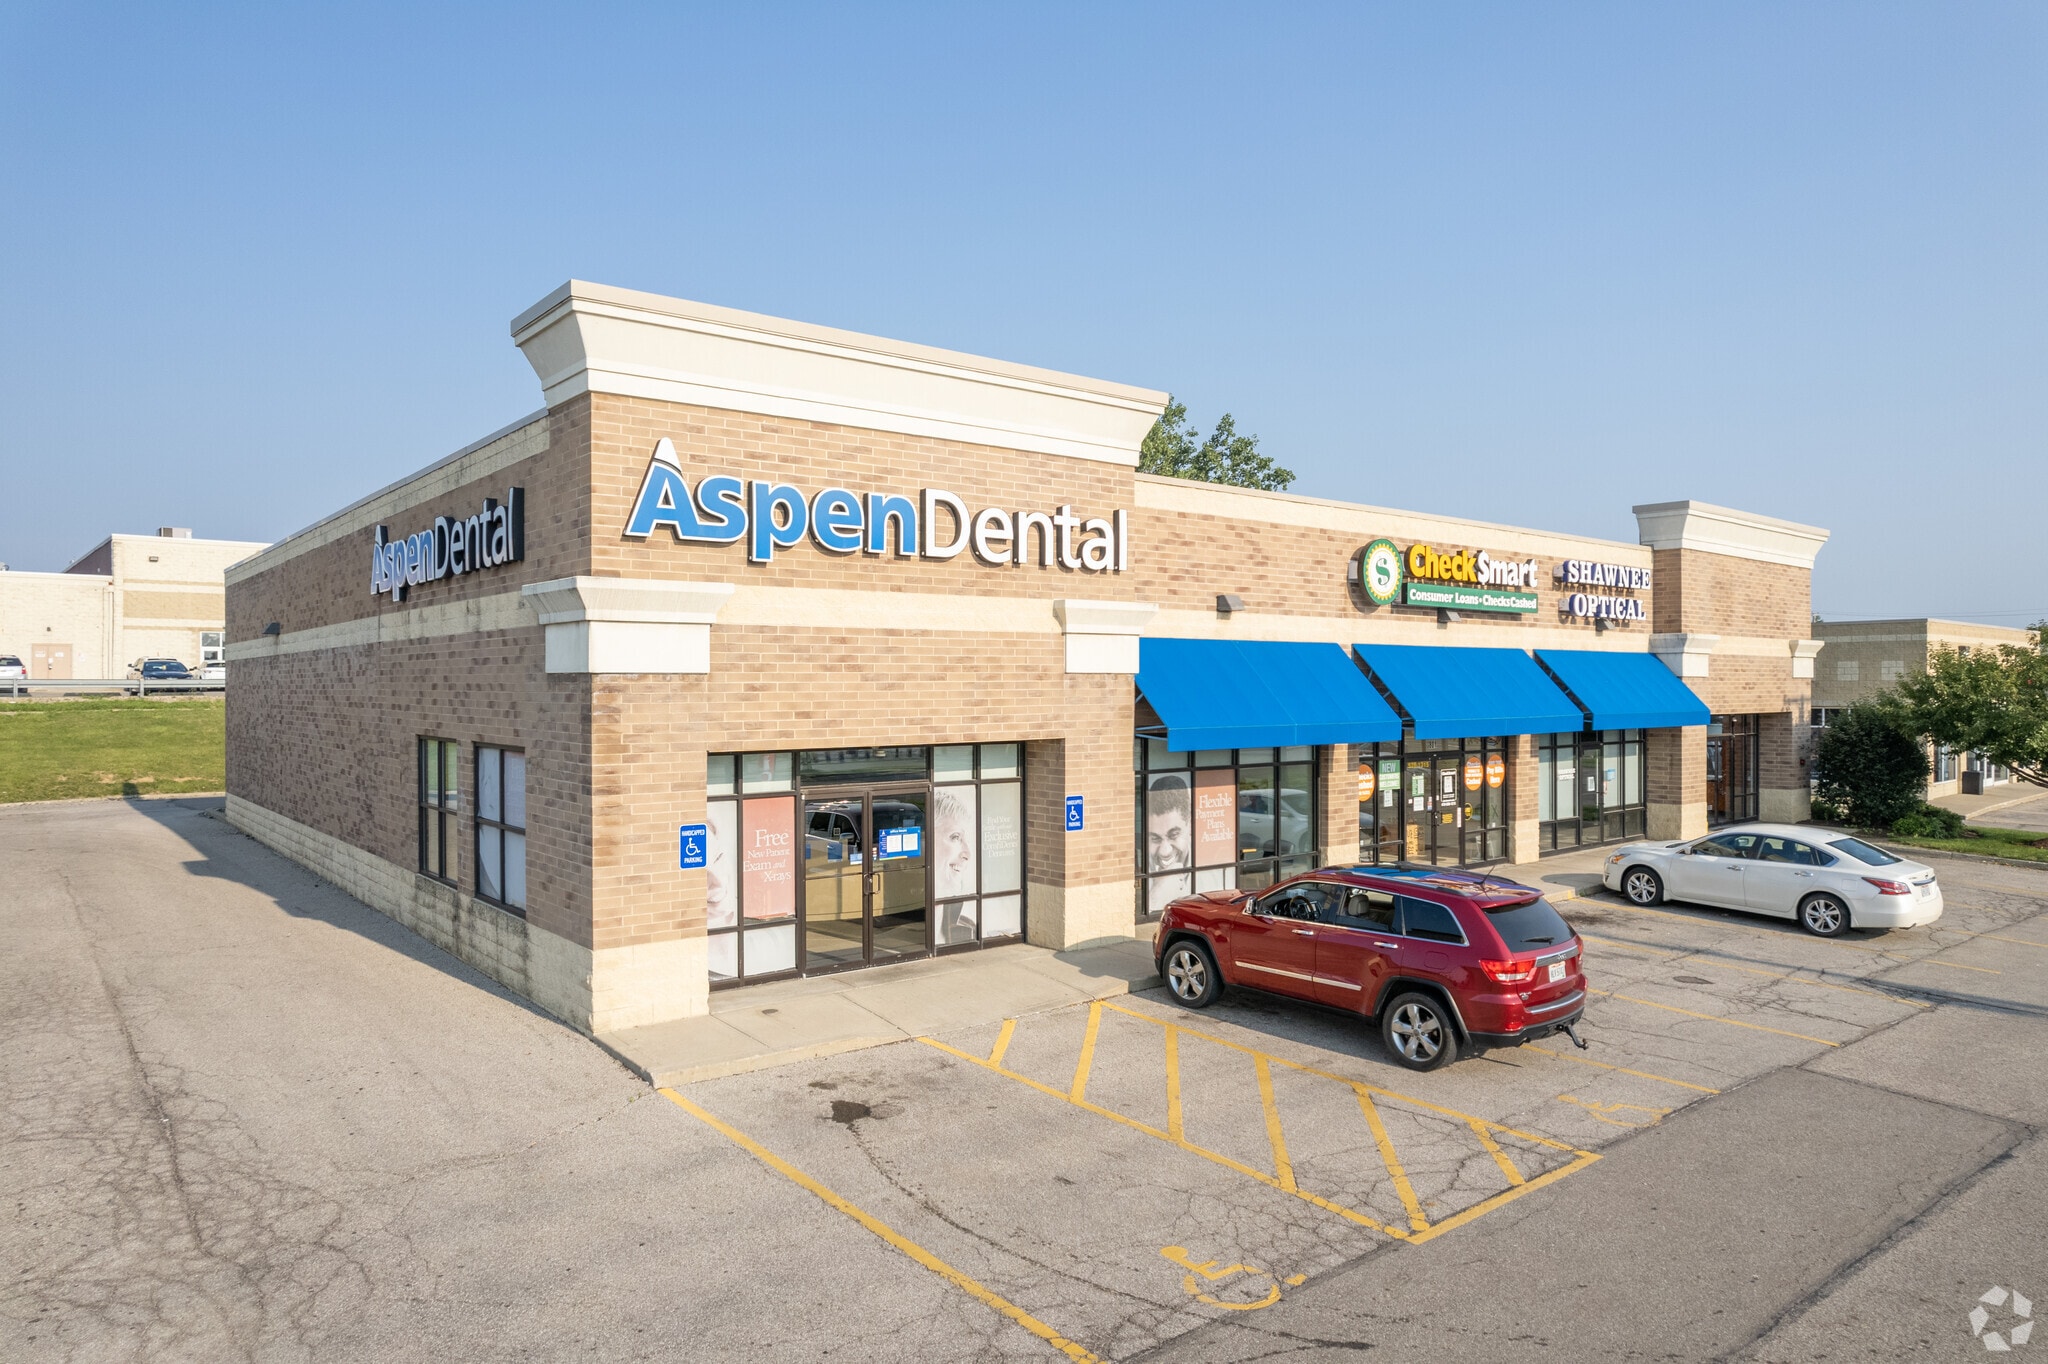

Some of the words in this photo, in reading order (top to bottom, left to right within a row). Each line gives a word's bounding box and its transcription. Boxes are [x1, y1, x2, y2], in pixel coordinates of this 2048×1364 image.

[1567, 560, 1651, 590] SHAWNEE
[1409, 588, 1454, 604] Consumer
[1573, 593, 1646, 620] OPTICAL
[1382, 762, 1396, 773] NEW
[1199, 792, 1233, 808] Flexible
[1195, 809, 1225, 822] Payment
[1207, 818, 1225, 829] Plans
[755, 829, 790, 848] Free
[984, 830, 1018, 842] Exclusive
[1200, 828, 1234, 842] Available
[747, 850, 764, 859] New
[766, 848, 790, 857] Patient
[743, 861, 771, 872] Exam
[773, 859, 786, 869] and
[764, 871, 791, 884] X-rays
